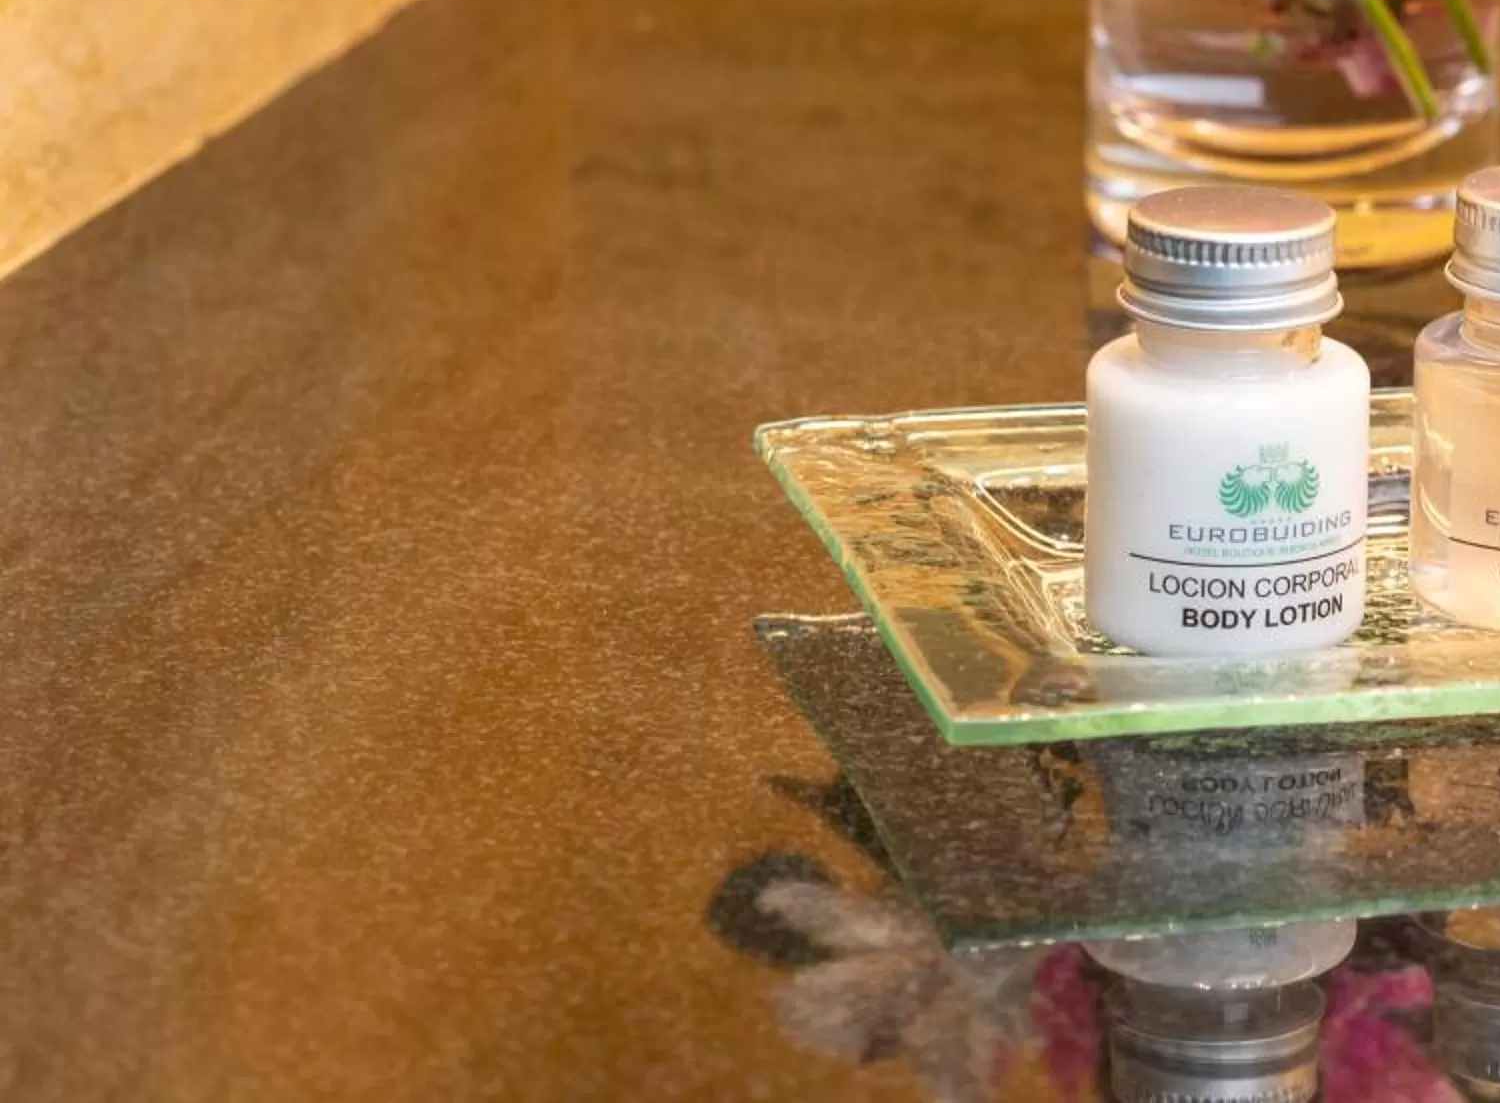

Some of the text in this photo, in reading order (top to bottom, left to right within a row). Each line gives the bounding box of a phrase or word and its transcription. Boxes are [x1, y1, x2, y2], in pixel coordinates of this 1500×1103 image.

[1168, 509, 1352, 544] EUROBUIDING
[1149, 571, 1245, 599] LOCION
[1182, 593, 1344, 629] BODY LOTION
